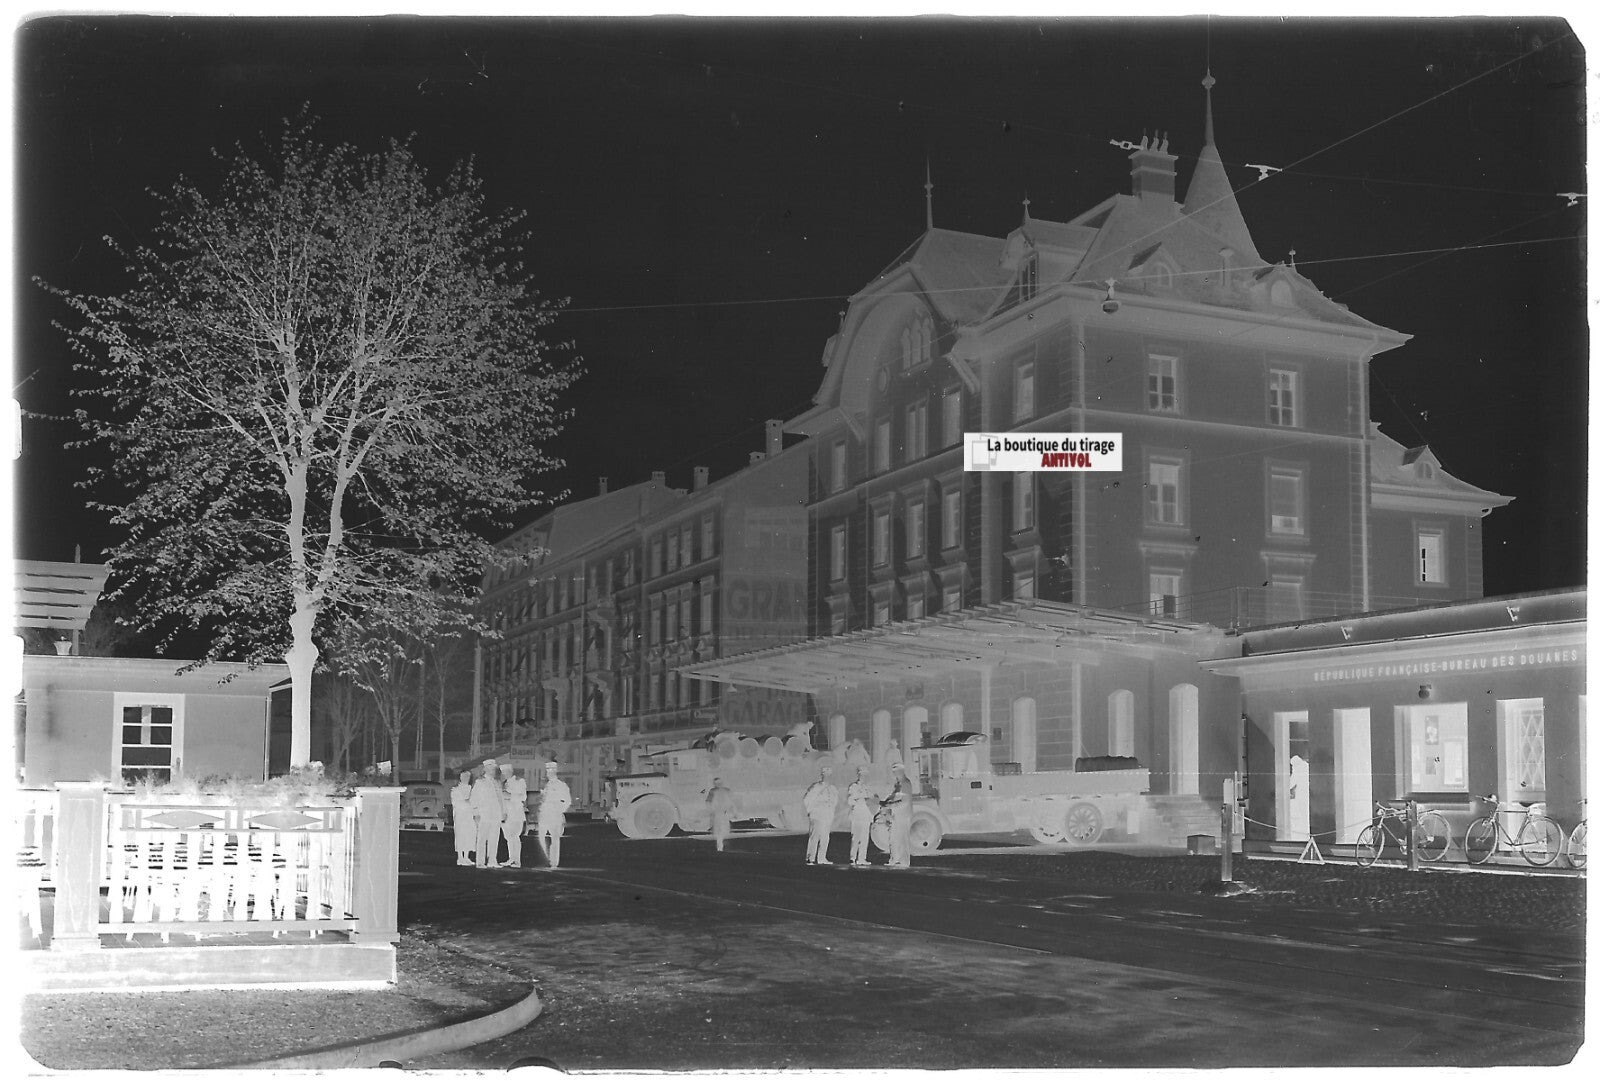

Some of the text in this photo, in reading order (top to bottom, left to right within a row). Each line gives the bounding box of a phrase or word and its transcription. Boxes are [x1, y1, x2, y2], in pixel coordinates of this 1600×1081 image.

[1314, 666, 1374, 682] RÉPUBLIQUE
[1492, 655, 1515, 668] DES
[1520, 649, 1578, 665] DOUANES
